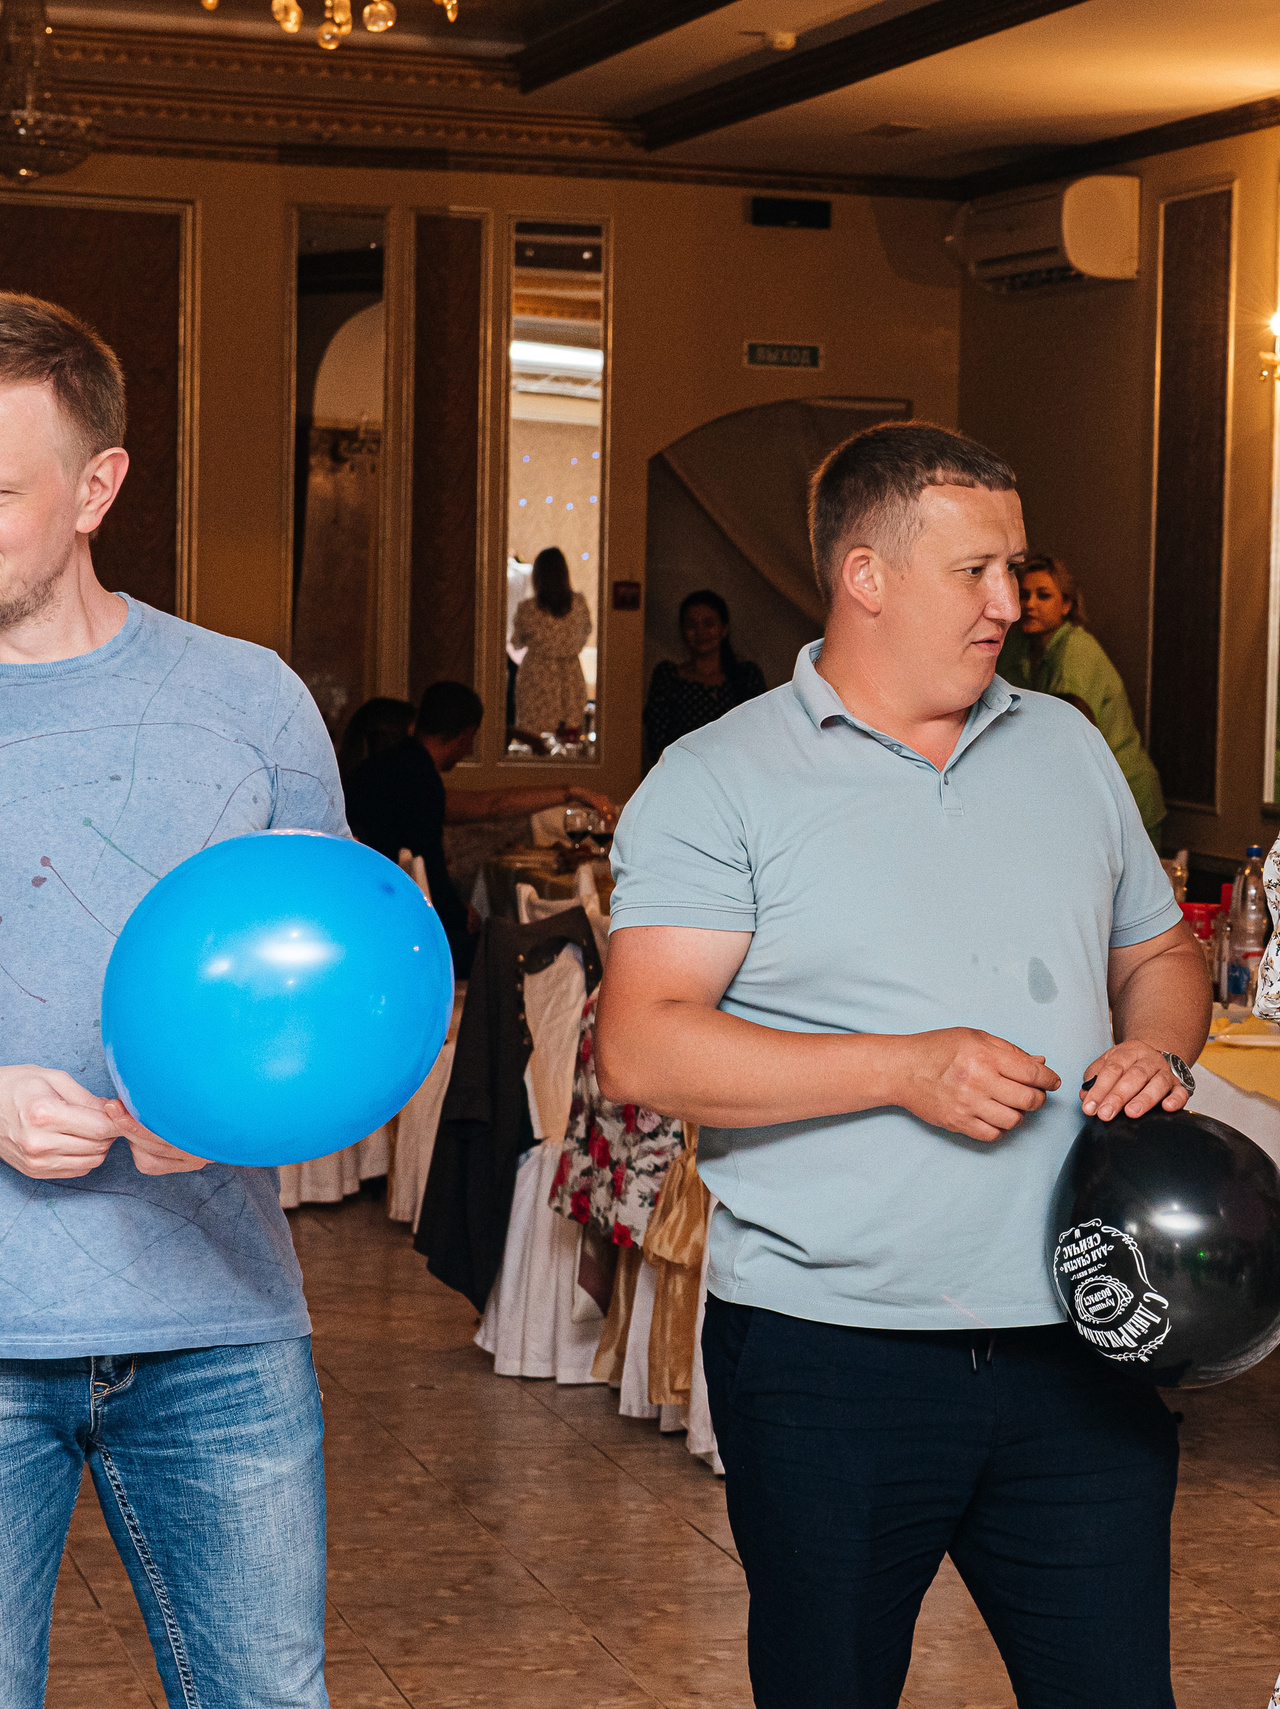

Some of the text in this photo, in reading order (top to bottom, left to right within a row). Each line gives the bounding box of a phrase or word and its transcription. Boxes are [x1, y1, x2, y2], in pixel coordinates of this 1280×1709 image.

[1062, 1233, 1101, 1259] СЕЙЧАС
[1092, 1243, 1108, 1259] ДЛЯ
[1083, 1287, 1112, 1306] ВОЗРАСТ
[1088, 1298, 1116, 1315] Лучший
